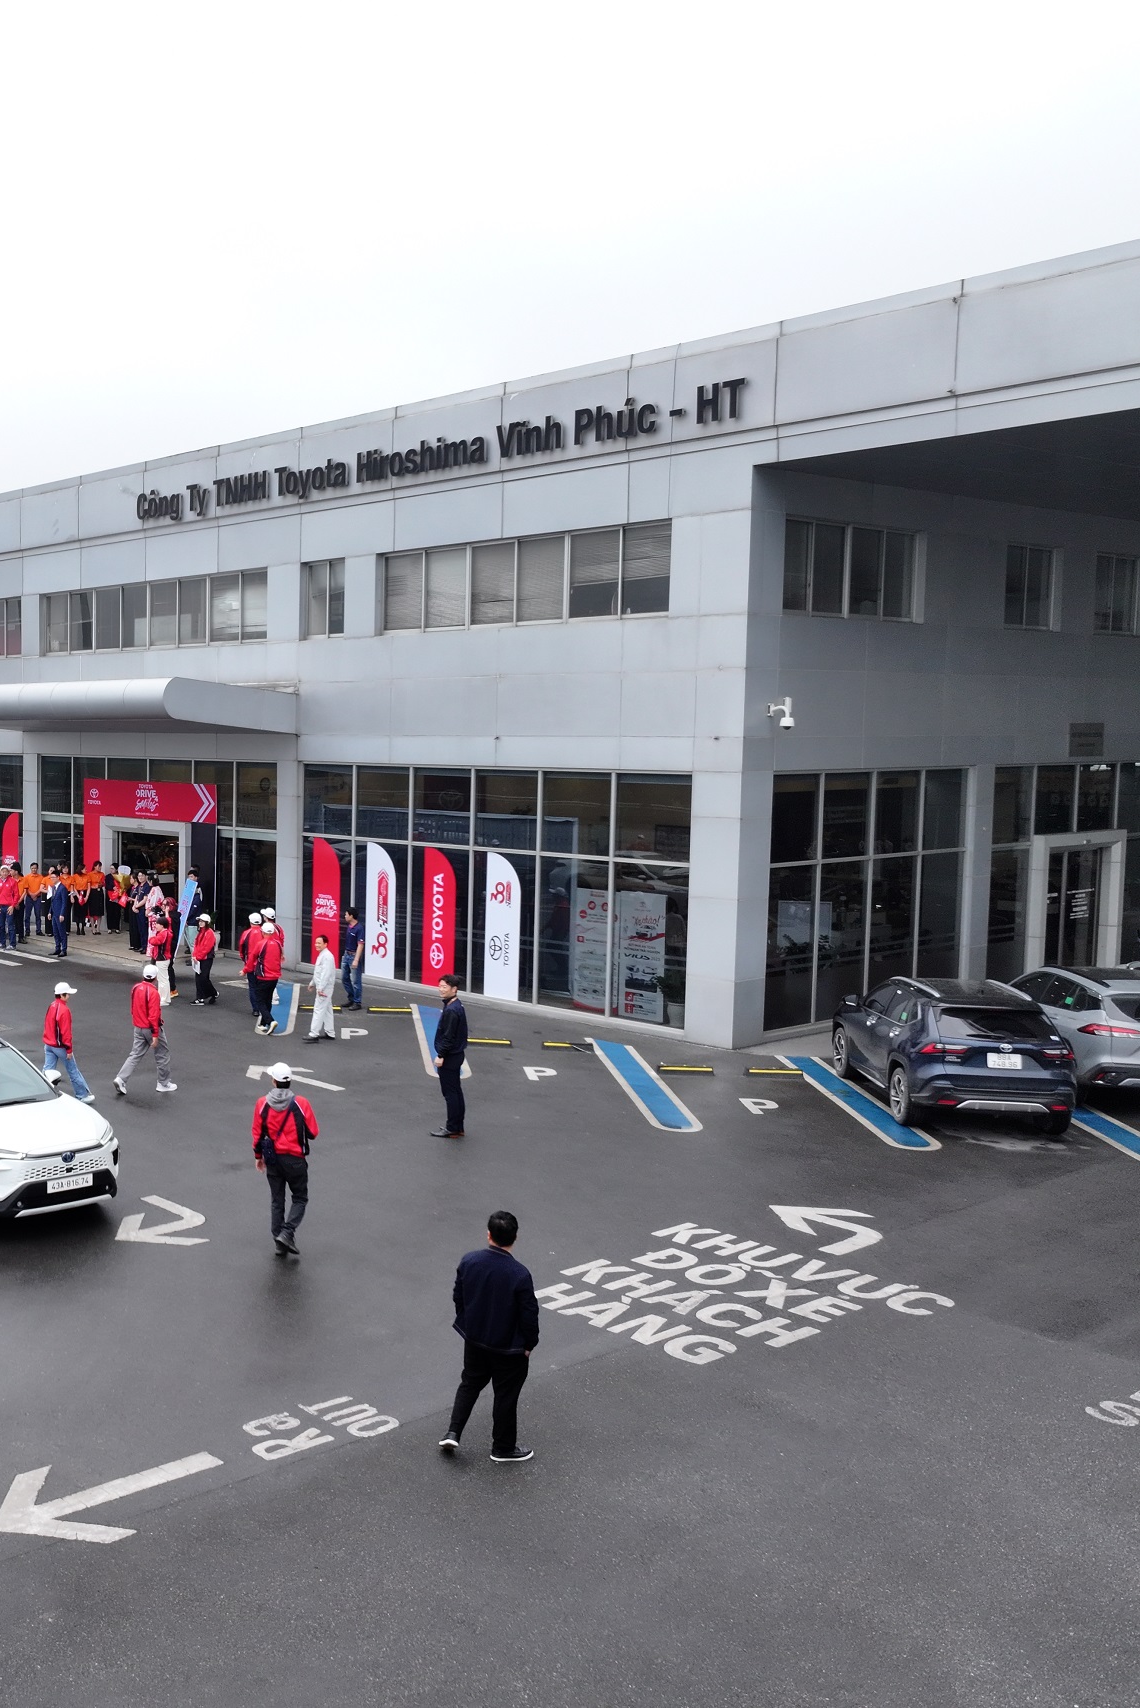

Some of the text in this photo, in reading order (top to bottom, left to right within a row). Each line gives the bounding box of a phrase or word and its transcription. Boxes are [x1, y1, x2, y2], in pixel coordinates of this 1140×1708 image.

[137, 491, 182, 521] Công
[186, 483, 207, 517] Ty
[213, 469, 269, 507] TNHH
[275, 457, 348, 500] Toyota
[356, 434, 488, 483] Hiroshima
[496, 415, 564, 458] Vĩnh
[574, 397, 659, 446] Phúc
[697, 378, 748, 425] HT
[432, 873, 445, 941] TOYOTA
[490, 882, 506, 904] 30
[371, 932, 388, 959] 30
[341, 1027, 369, 1040] P
[522, 1066, 557, 1081] P
[739, 1098, 779, 1114] P
[651, 1222, 803, 1268] KHU
[560, 1258, 821, 1348] KHÁCH
[734, 1278, 863, 1323] XE
[534, 1283, 737, 1365] HÀNG
[298, 1396, 400, 1438] OUT
